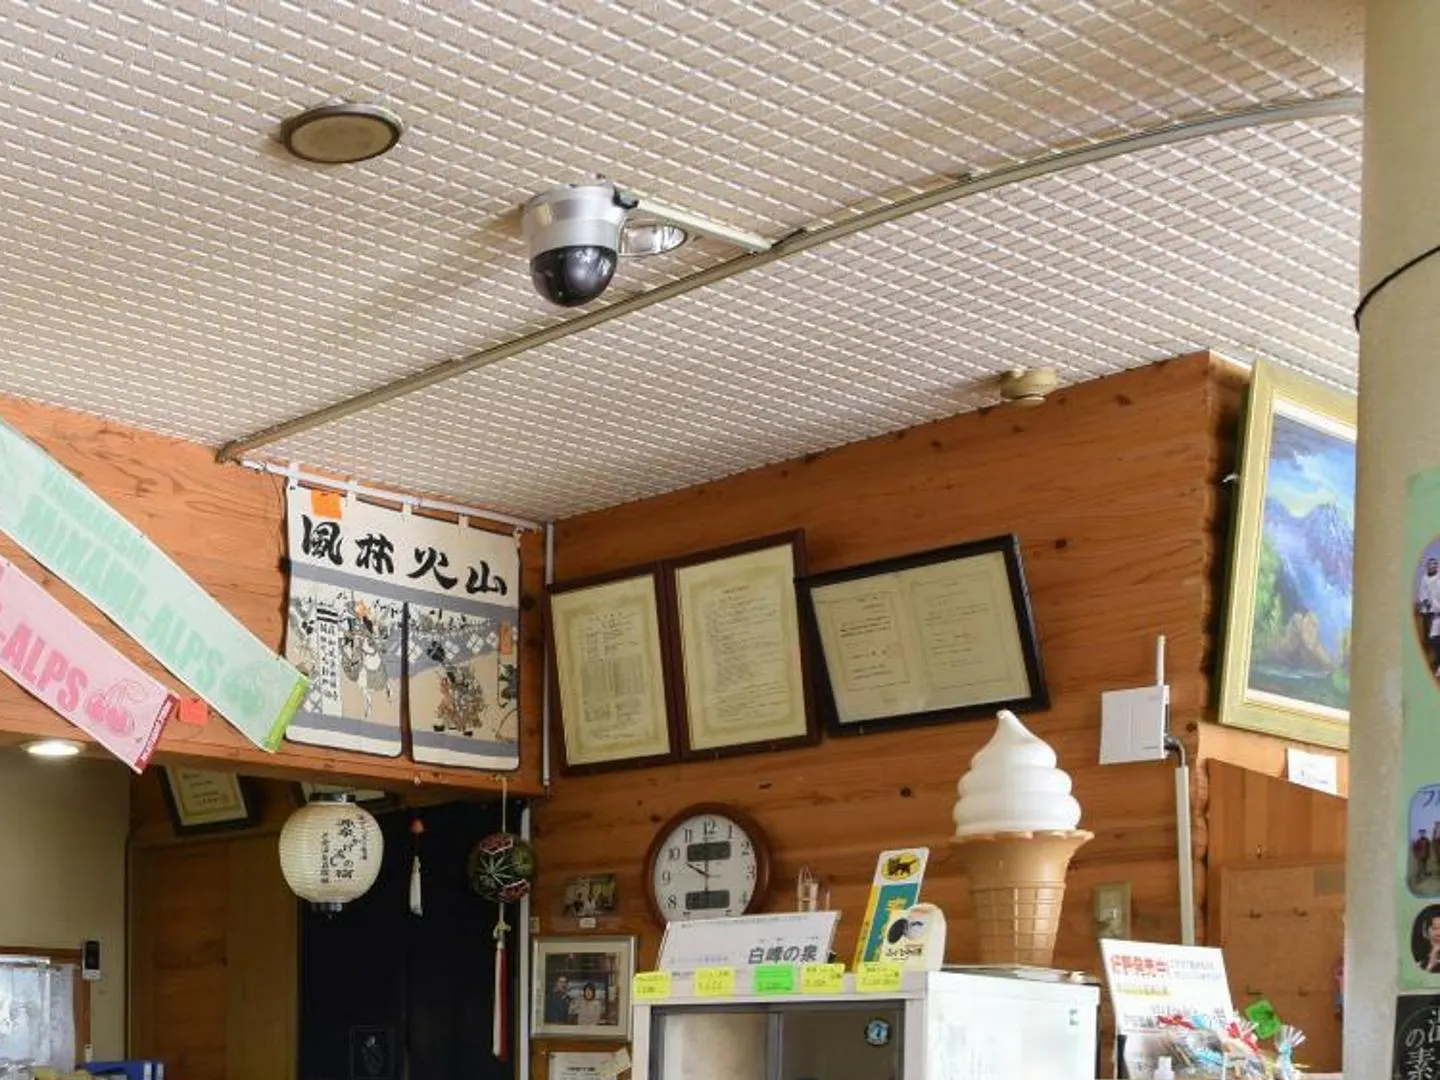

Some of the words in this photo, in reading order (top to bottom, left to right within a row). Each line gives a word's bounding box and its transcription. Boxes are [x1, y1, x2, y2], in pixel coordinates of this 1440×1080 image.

[40, 463, 152, 566] YAMANASHI
[301, 514, 508, 596] 風林火山
[18, 491, 227, 689] MINAMI-ALPS
